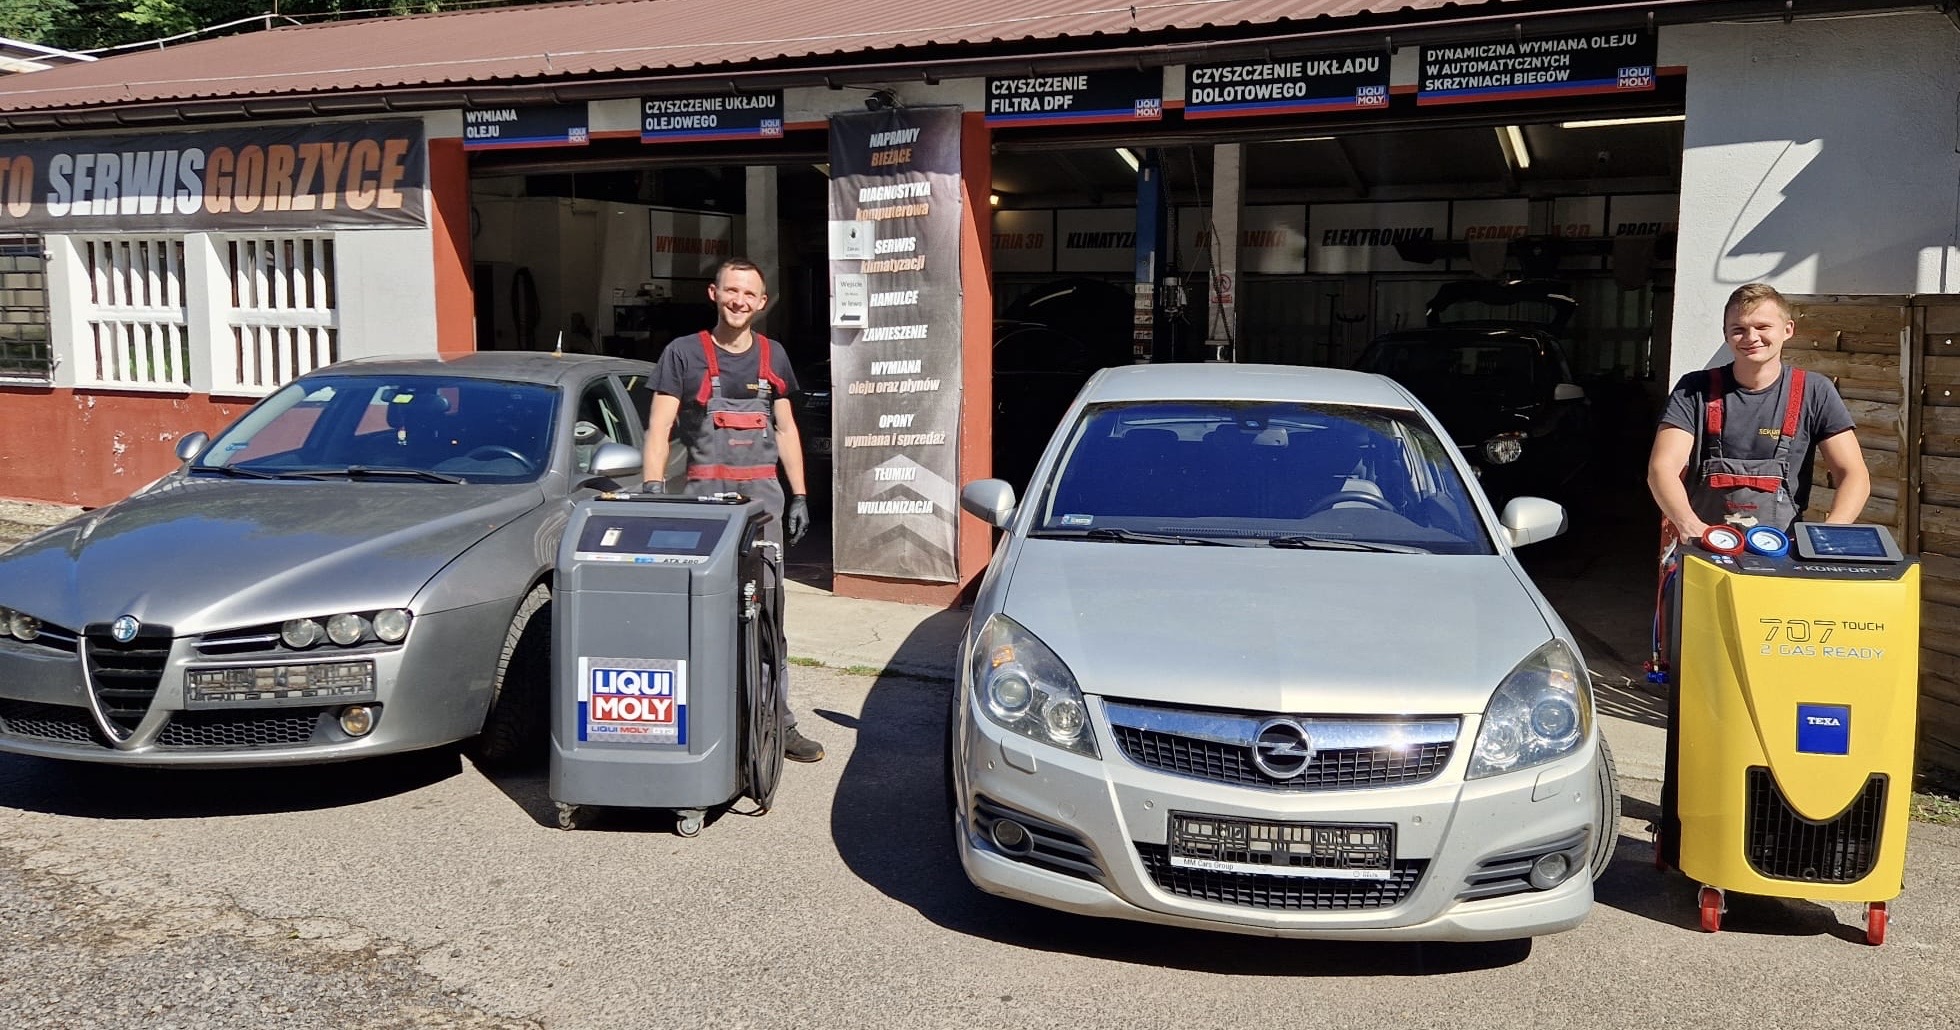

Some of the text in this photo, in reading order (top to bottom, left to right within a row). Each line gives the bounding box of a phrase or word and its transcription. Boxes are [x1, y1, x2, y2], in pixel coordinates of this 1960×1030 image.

[1427, 34, 1638, 62] DYNAMICZNA WYMIANA OLEJU
[1192, 56, 1380, 84] CZYSZCZENIE UKŁADU
[1426, 54, 1570, 76] W AUTOMATYCZNYCH
[1620, 67, 1650, 78] LIQUI
[991, 76, 1088, 94] CZYSZCZENIE
[1425, 68, 1570, 90] SKRZYNIACH BIEGÓW
[1620, 77, 1650, 87] MOLY
[1192, 82, 1307, 104] DOLOTOWEGO
[1358, 86, 1385, 96] LIQUI
[645, 94, 776, 114] CZYSZCZENIE UKŁADU
[991, 95, 1074, 113] FILTRA DPF
[1136, 99, 1161, 108] LIQUI
[1358, 96, 1385, 105] MOLY
[466, 108, 518, 123] WYMIANA
[1136, 108, 1161, 116] MOLY
[645, 114, 718, 130] OLEJOWEGO
[466, 125, 500, 138] OLEJU
[760, 128, 780, 136] MOLY
[869, 128, 920, 148] NAPRAWY
[859, 181, 931, 202] DIAGNOSTYKA
[855, 203, 930, 221] komputerowa
[874, 236, 917, 254] SERWIS
[1322, 227, 1434, 247] ELEKTRONIKA
[860, 255, 926, 274] klimatyzacji
[870, 290, 919, 307] HAMULCE
[861, 324, 929, 342] ZAWIESZENIE
[870, 360, 922, 376] WYMIANA
[848, 377, 941, 395] oleju oraz płynów
[878, 414, 915, 428] OPONY
[844, 434, 891, 448] wymiana
[897, 430, 946, 447] sprzedaż
[874, 467, 917, 481] TŁUMIKI
[857, 500, 935, 514] WULKANIZACJA
[1804, 565, 1888, 574] KONFORT
[1760, 618, 1884, 644] 707 TOUCH
[1760, 644, 1884, 660] 2 GAS READY
[595, 671, 670, 696] LIQUI
[595, 696, 672, 721] MOLY
[1807, 716, 1840, 726] TEXA
